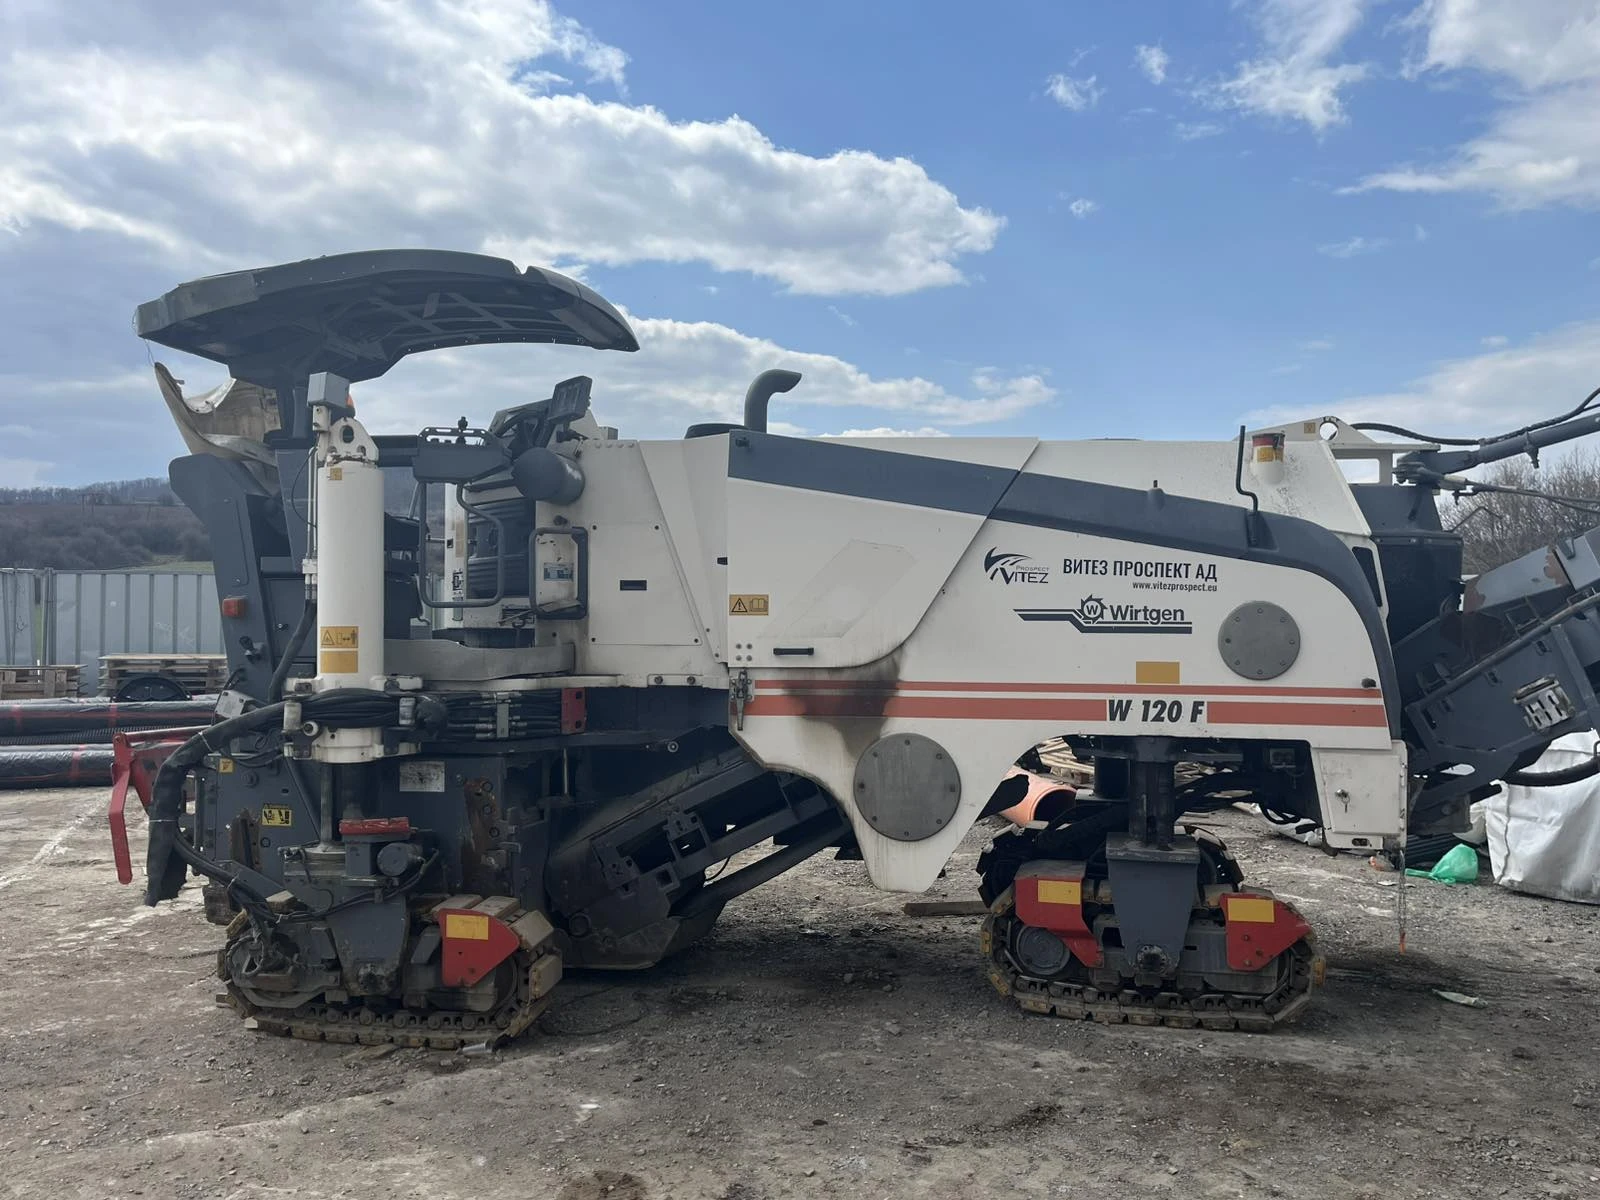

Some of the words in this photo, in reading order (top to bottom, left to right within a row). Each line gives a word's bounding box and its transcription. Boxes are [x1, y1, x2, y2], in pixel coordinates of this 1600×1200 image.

[1000, 567, 1049, 585] VITEZ
[1063, 558, 1108, 576] ВИТЕЗ
[1113, 560, 1191, 579] ПРОСПЕКТ
[1195, 563, 1218, 582] АД
[1132, 581, 1218, 593] www.vitezprospect.eu
[1109, 604, 1185, 625] Wirtgen
[1108, 699, 1133, 722] W
[1141, 699, 1183, 723] 120
[1190, 701, 1205, 723] F
